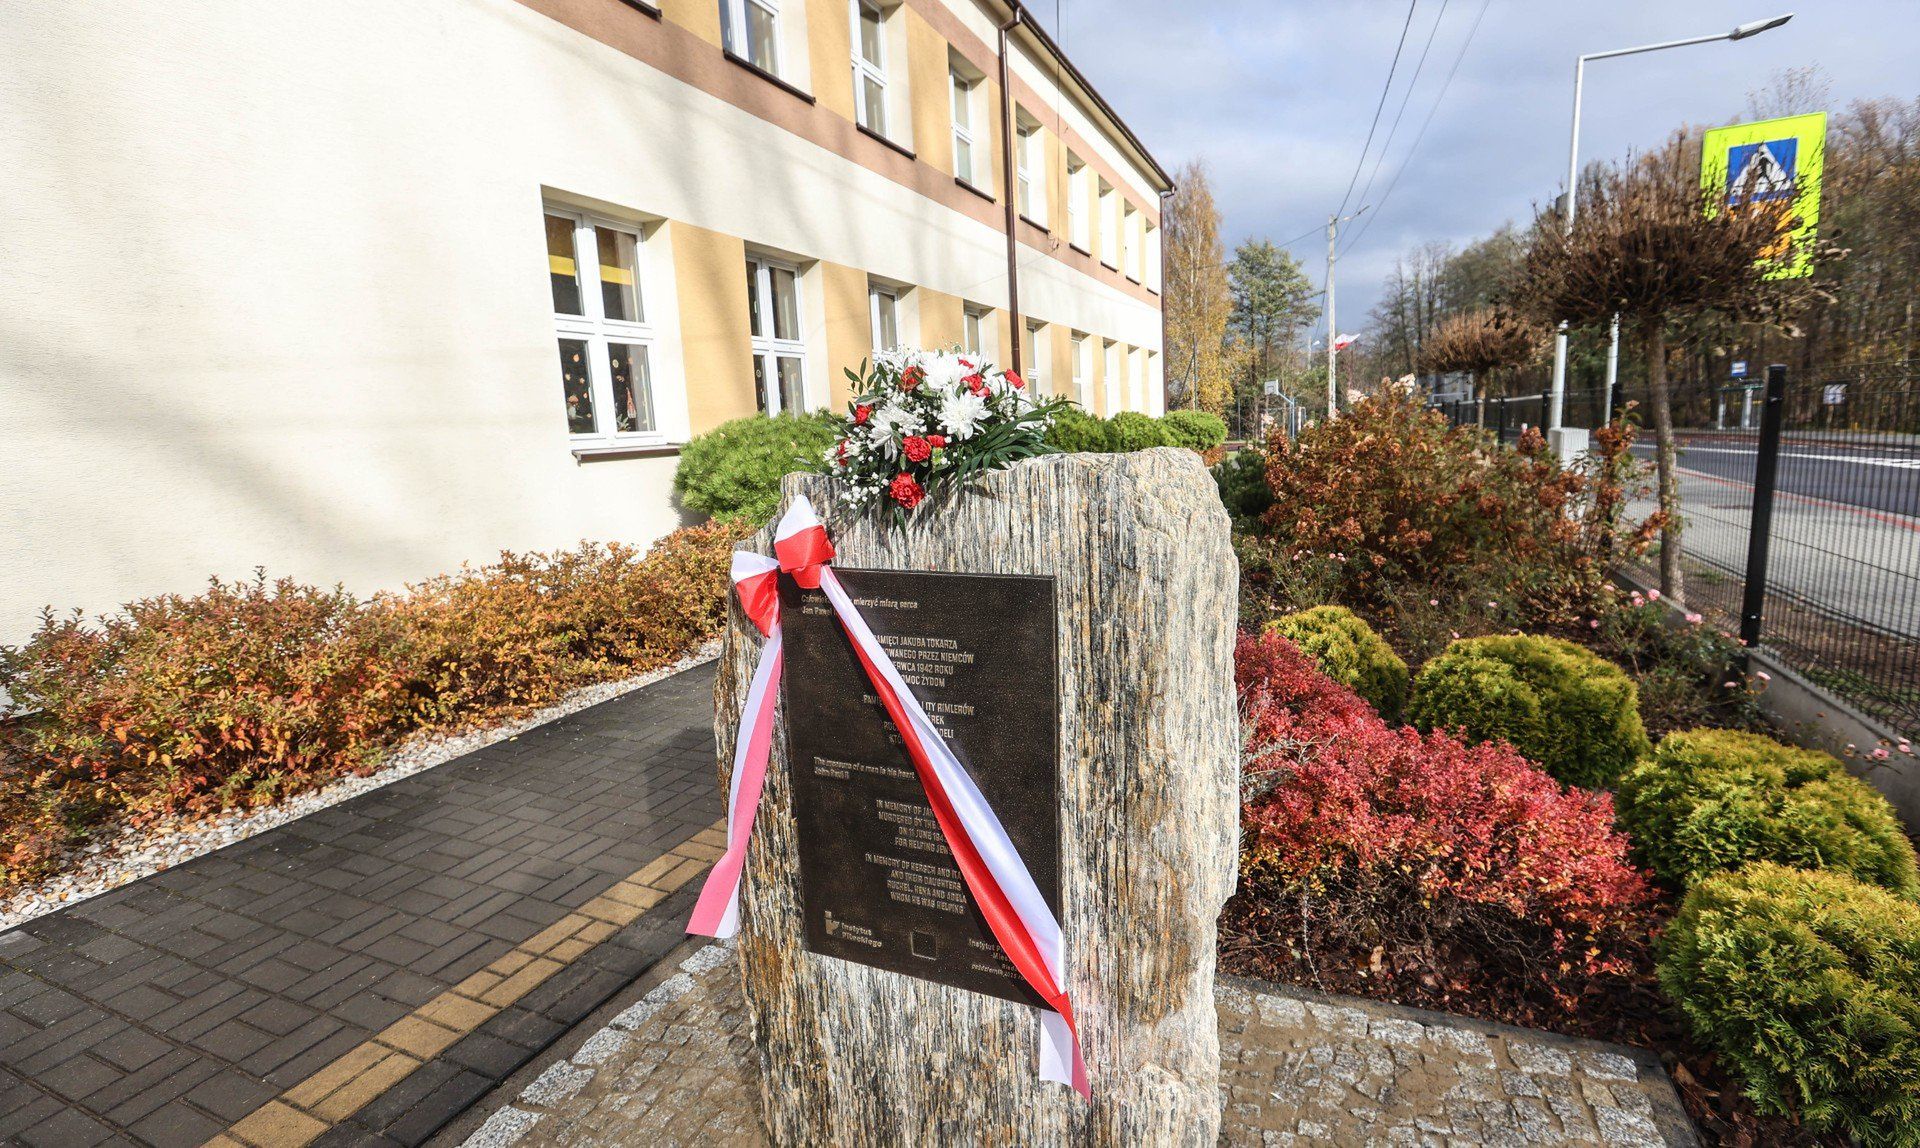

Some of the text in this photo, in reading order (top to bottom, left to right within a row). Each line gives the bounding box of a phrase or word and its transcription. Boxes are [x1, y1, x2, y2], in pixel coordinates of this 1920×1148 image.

[802, 606, 813, 615] Jan
[854, 598, 878, 608] mierzyć
[880, 598, 898, 610] miarą
[900, 601, 918, 609] serca
[874, 635, 958, 650] AMIĘCI JAKUBA TOKARZA
[884, 648, 974, 664] OWANEGO PRZEZ NIEMCÓW
[892, 662, 954, 675] ERWCA 1942 ROKU
[902, 674, 946, 687] OMOC ŻYDOM
[926, 702, 936, 712] ITY
[938, 702, 974, 716] RIMLERÓW
[936, 728, 954, 738] DELI
[814, 756, 825, 766] The
[852, 762, 860, 770] of
[866, 766, 878, 774] man
[886, 768, 897, 776] his
[876, 800, 884, 808] IN
[884, 800, 912, 814] MEMORY
[914, 806, 921, 815] OF
[878, 812, 912, 825] MURDERED
[914, 816, 923, 826] BY
[924, 819, 936, 829] THE
[898, 826, 908, 835] ON
[916, 829, 932, 840] JUNE
[895, 836, 908, 847] FOR
[908, 840, 934, 852] HELPING
[865, 852, 873, 862] IN
[874, 854, 900, 867] MEMORY
[902, 860, 910, 869] OF
[936, 867, 950, 878] AND
[890, 870, 962, 892] AND THEIR DAUGHTERS
[932, 888, 946, 899] AND
[890, 892, 964, 914] WHOM HE WAS HELPING
[842, 922, 872, 936] Instytut
[842, 932, 882, 948] Pileckiego
